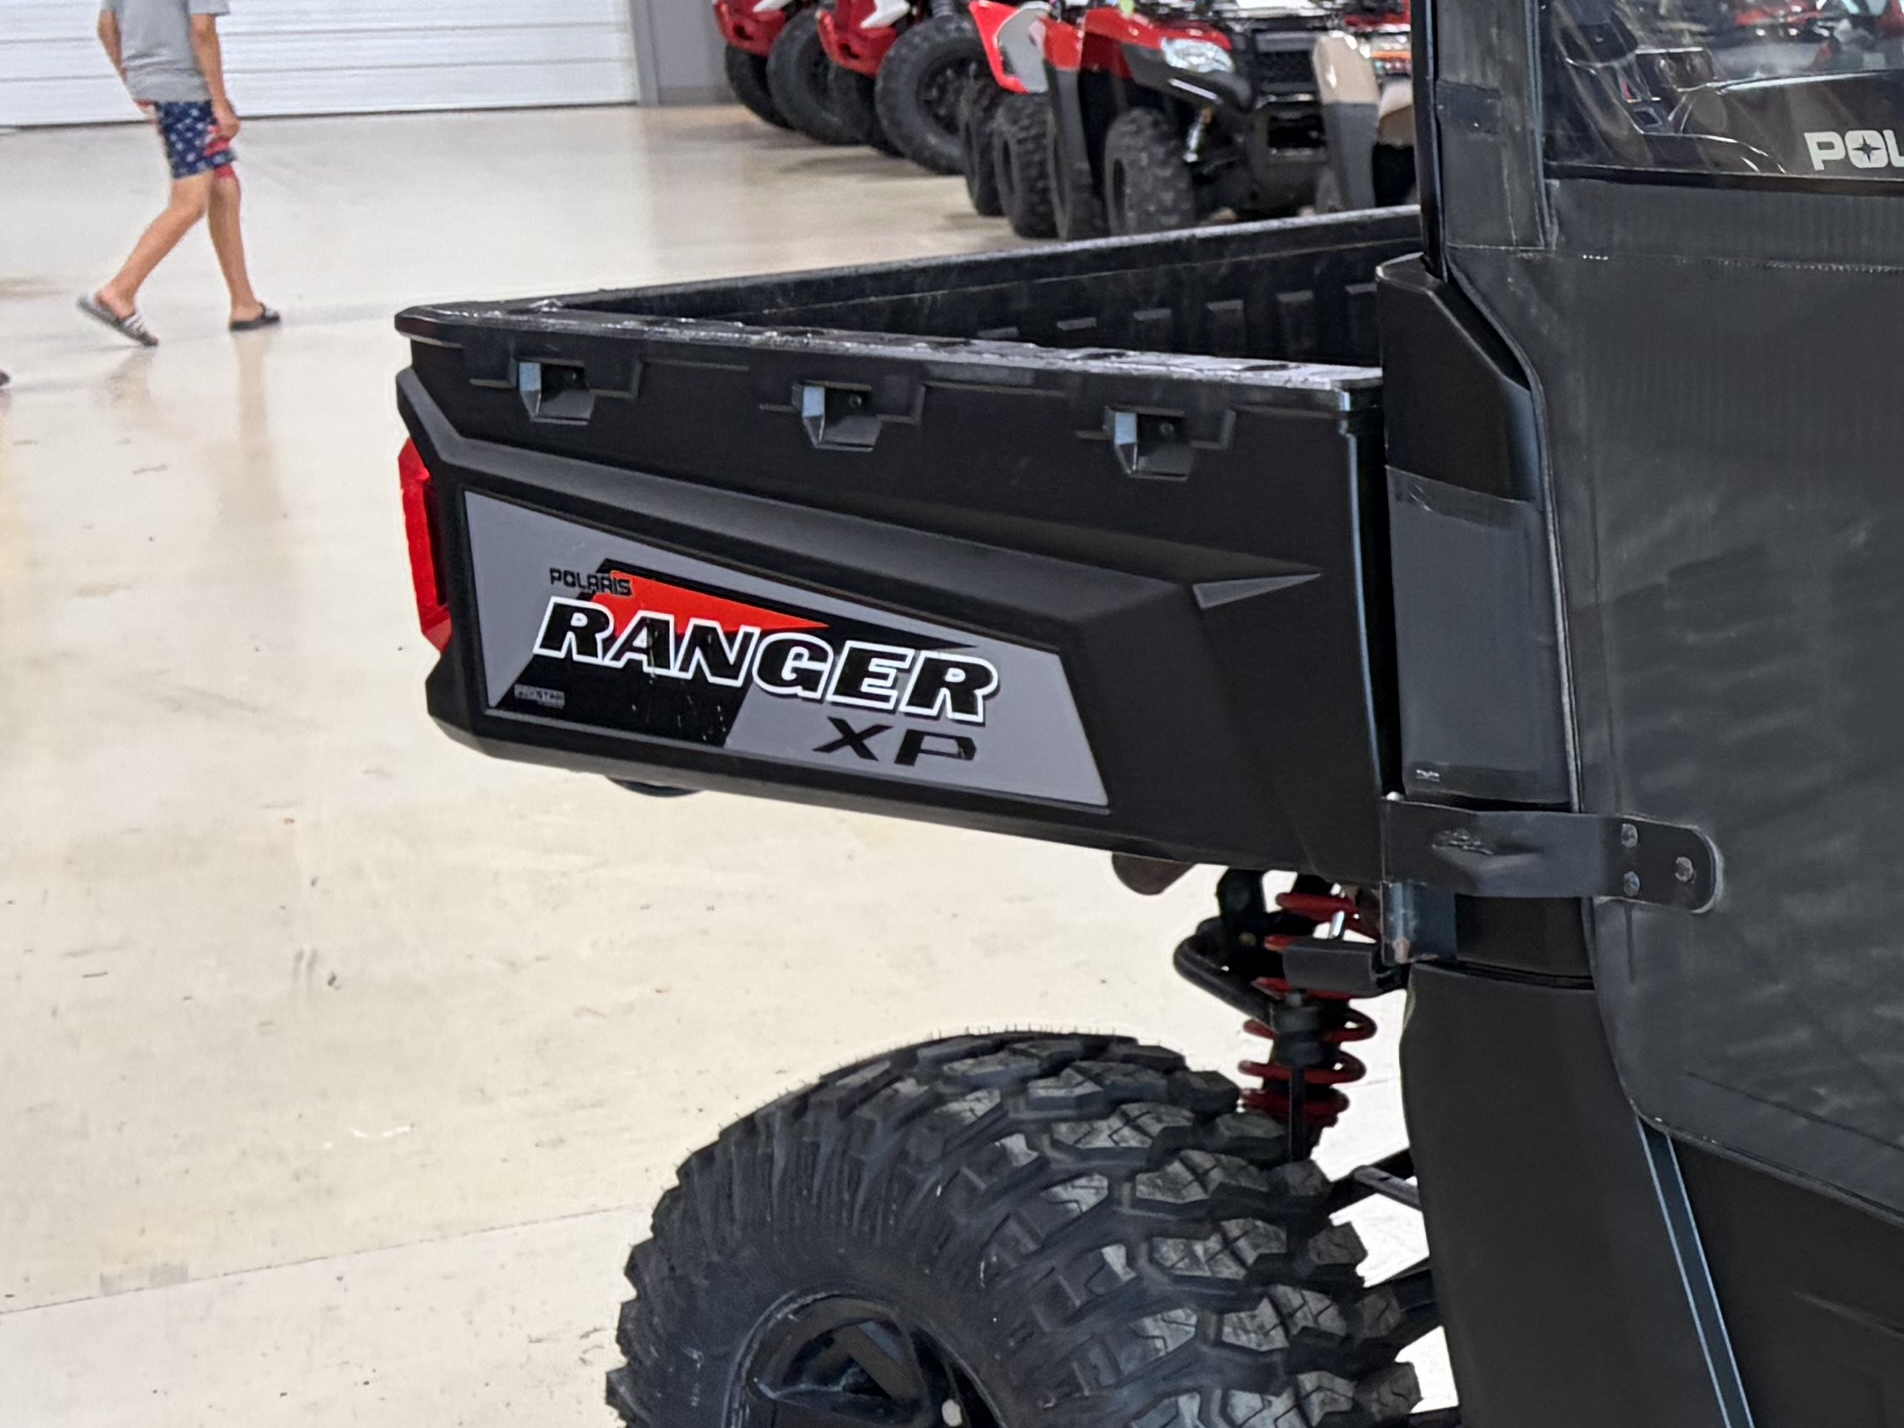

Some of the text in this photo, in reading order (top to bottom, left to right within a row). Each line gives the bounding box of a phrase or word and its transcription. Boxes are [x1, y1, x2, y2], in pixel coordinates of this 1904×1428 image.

[549, 567, 633, 597] POLARIS
[533, 596, 999, 724] RANGER
[812, 715, 978, 767] XP
